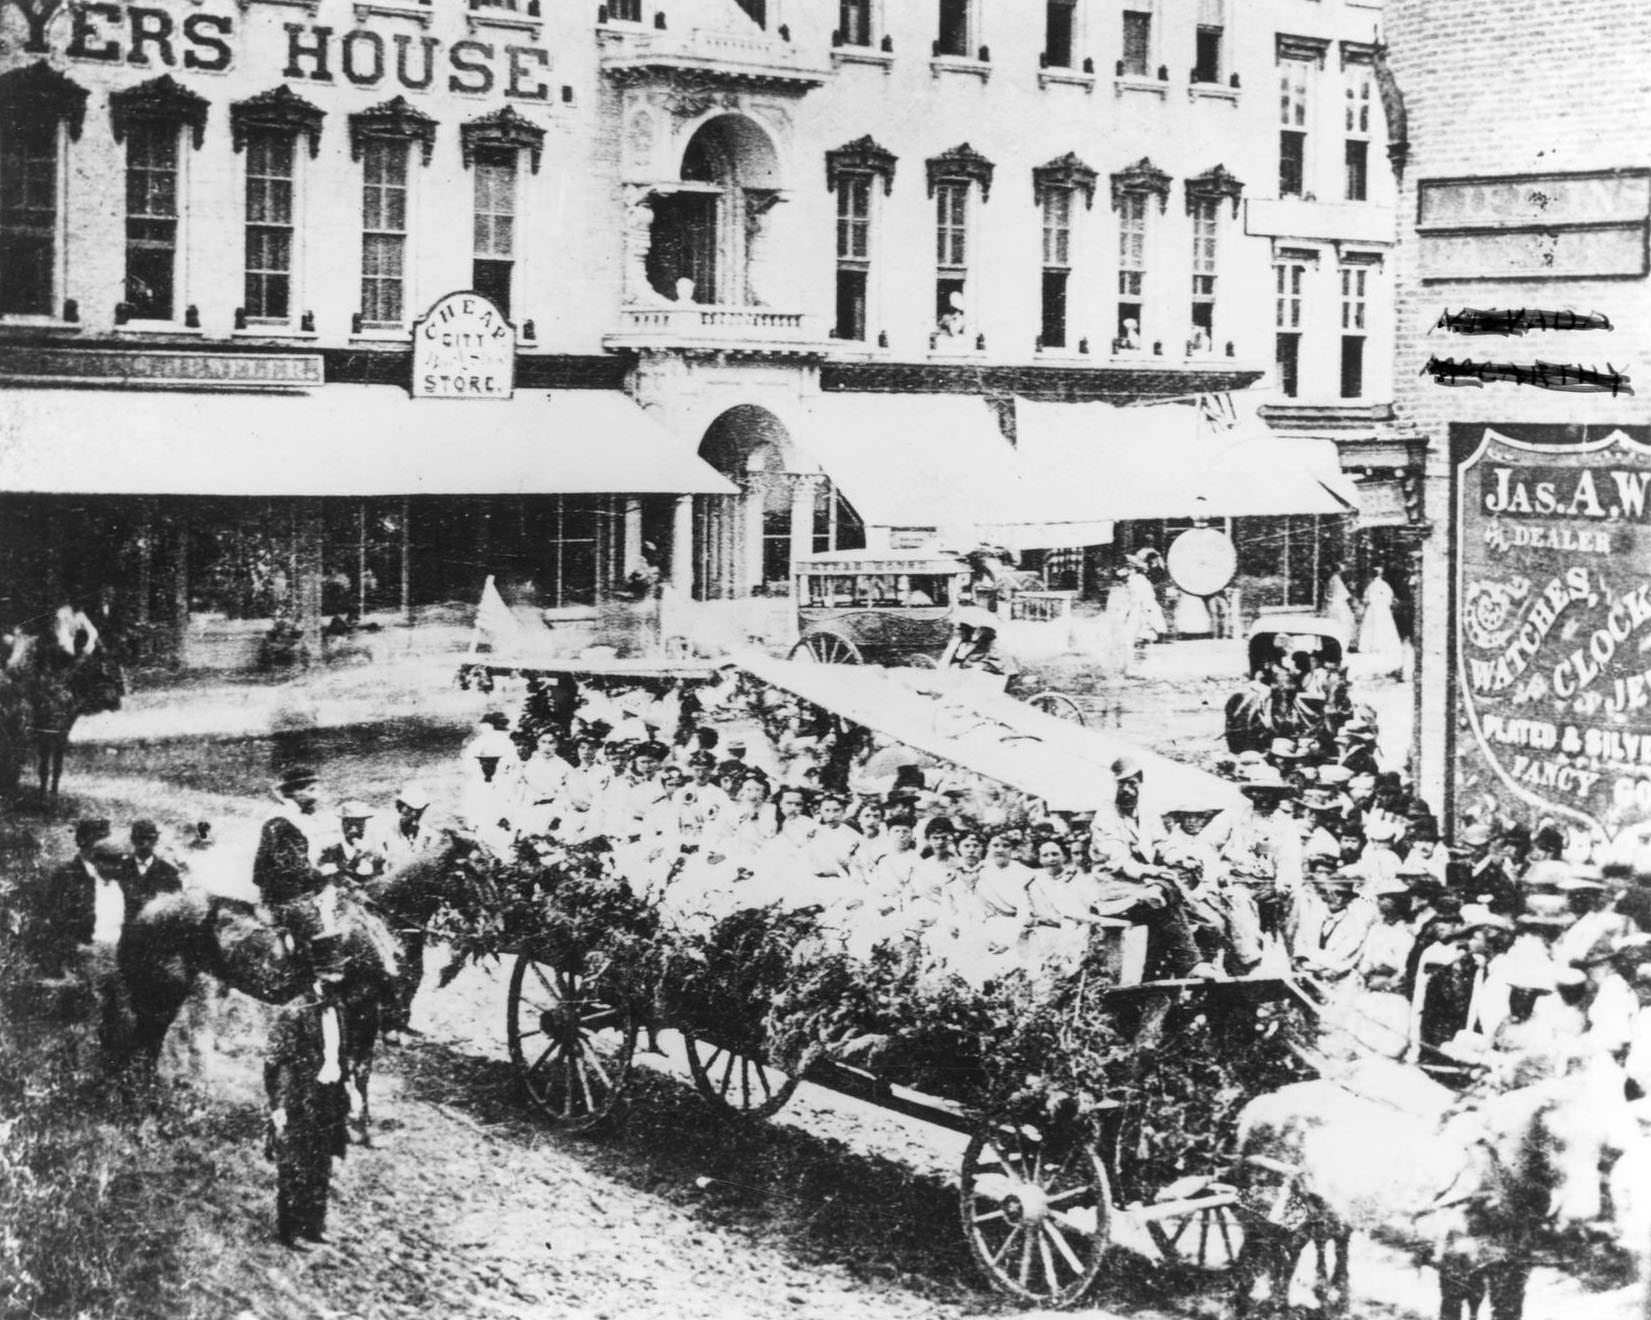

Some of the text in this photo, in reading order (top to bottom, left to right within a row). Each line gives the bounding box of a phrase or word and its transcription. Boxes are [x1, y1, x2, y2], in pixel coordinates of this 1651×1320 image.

[282, 22, 575, 101] HOUSE.
[425, 299, 506, 340] CHEAP
[1512, 526, 1610, 555] DEALER
[1562, 726, 1582, 752] &
[1511, 754, 1600, 797] FANCY
